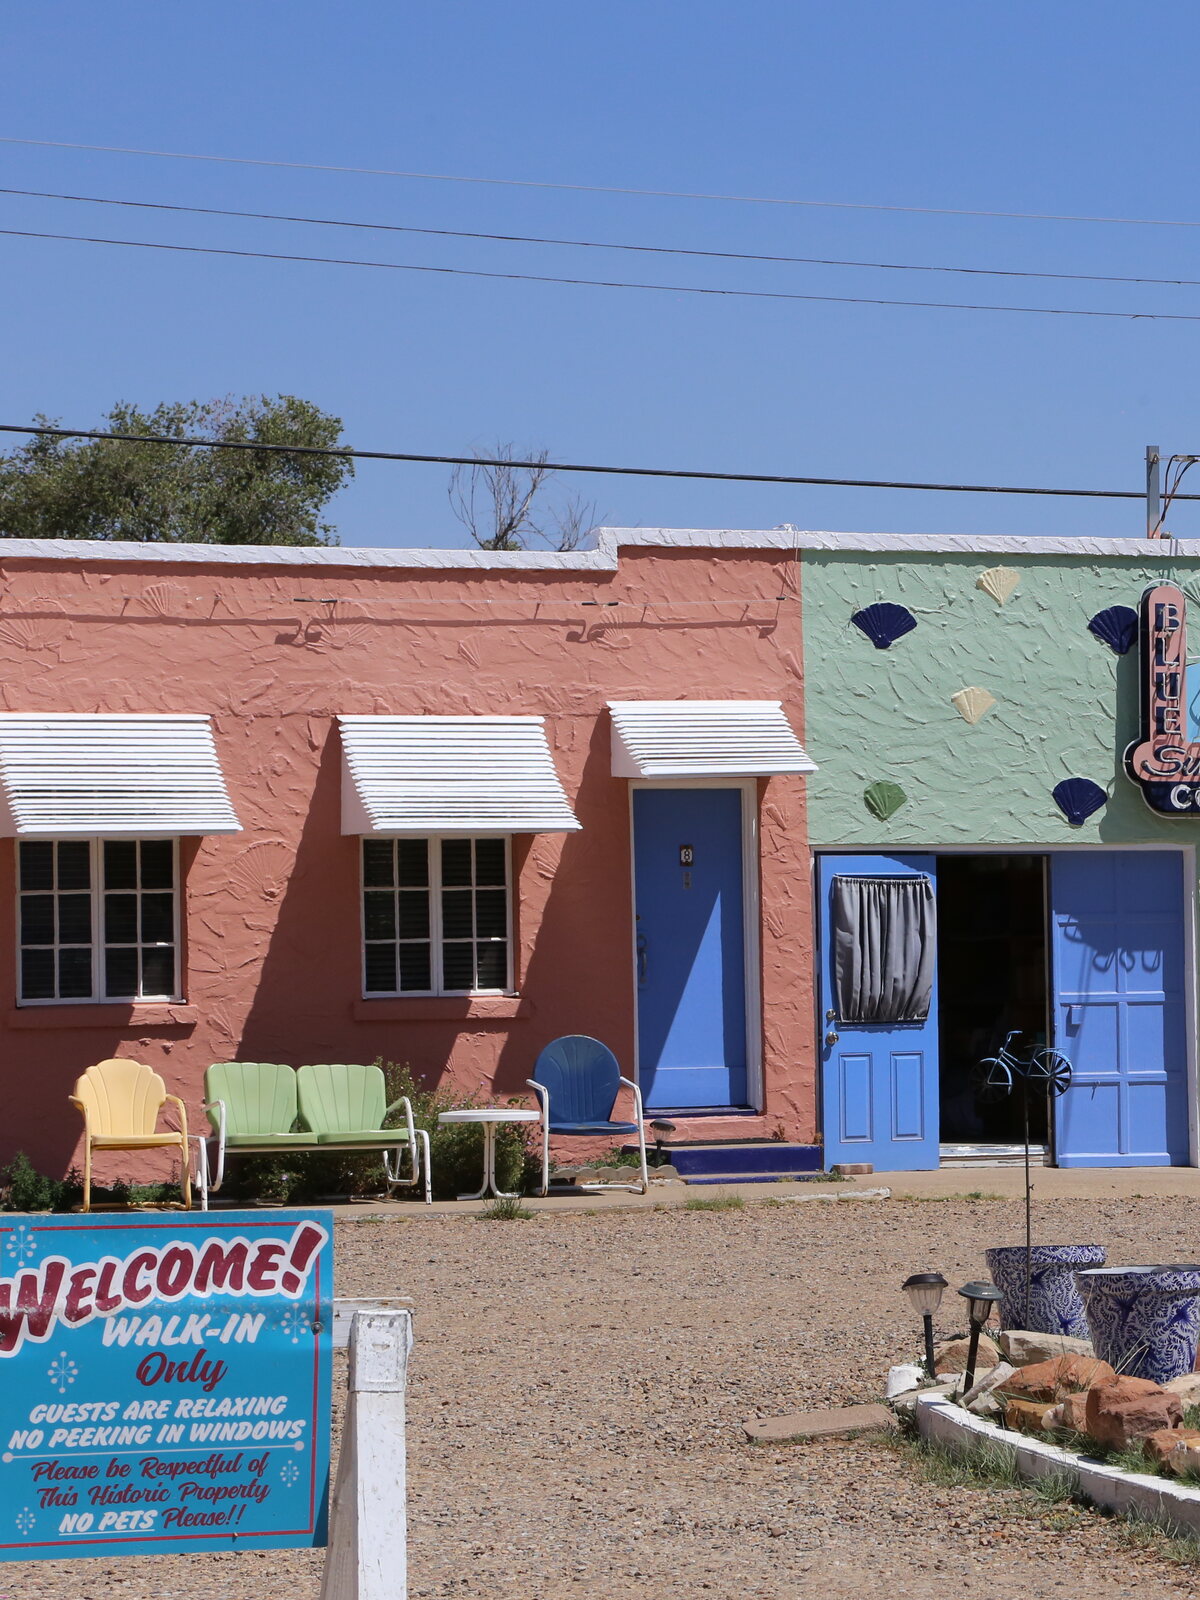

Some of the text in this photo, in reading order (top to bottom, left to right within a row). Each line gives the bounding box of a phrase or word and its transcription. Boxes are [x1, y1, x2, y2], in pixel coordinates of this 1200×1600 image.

[1154, 603, 1180, 736] BLUE
[0, 1225, 325, 1353] WELCOME!
[102, 1313, 266, 1347] WALK-IN
[136, 1348, 228, 1392] Only
[29, 1396, 288, 1424] GUESTS ARE RELAXING
[8, 1420, 306, 1449] NO PEEKING IN WINDOWS
[31, 1452, 271, 1482] Please be Respectful of
[36, 1478, 271, 1509] This Historic Property
[58, 1504, 247, 1533] NO PETS Please!!
